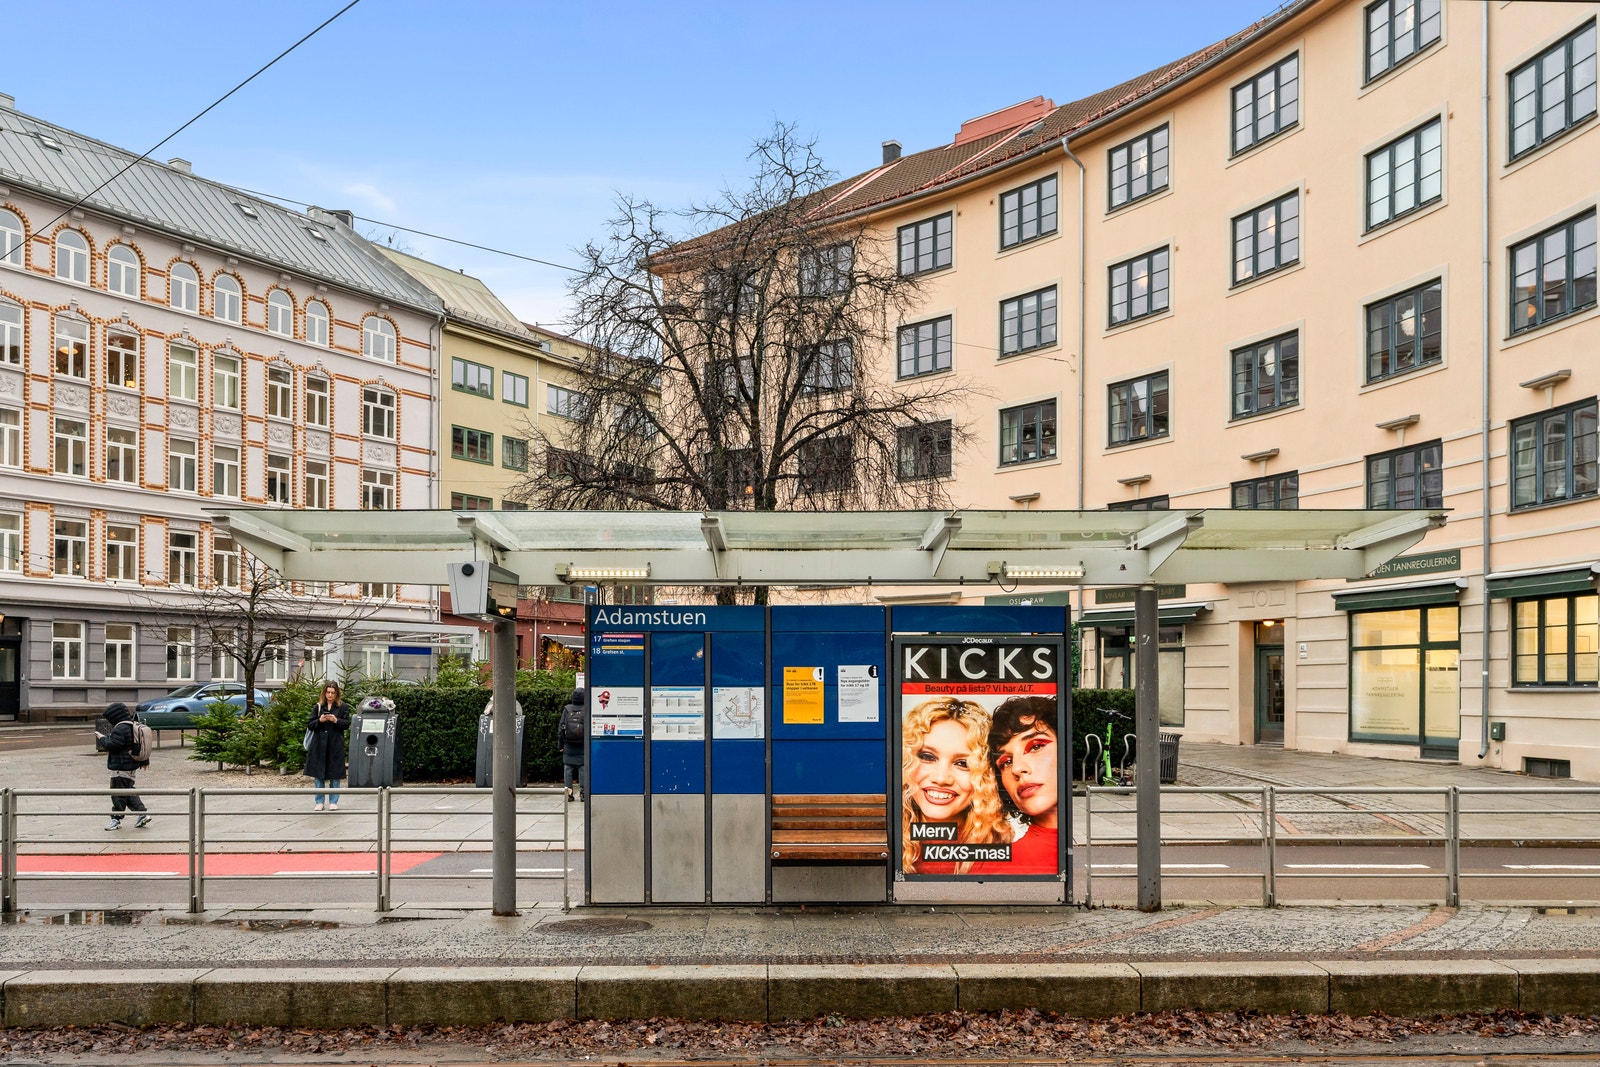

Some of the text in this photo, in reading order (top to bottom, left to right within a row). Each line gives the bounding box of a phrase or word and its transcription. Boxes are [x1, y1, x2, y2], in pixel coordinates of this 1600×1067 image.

[1393, 556, 1456, 571] TANNREGULERING
[594, 608, 706, 624] Adamstuen
[905, 647, 1053, 680] KICKS
[925, 685, 954, 694] Beauty
[956, 684, 967, 694] på
[913, 824, 956, 840] Merry
[924, 846, 1010, 860] KICKS-mas!
